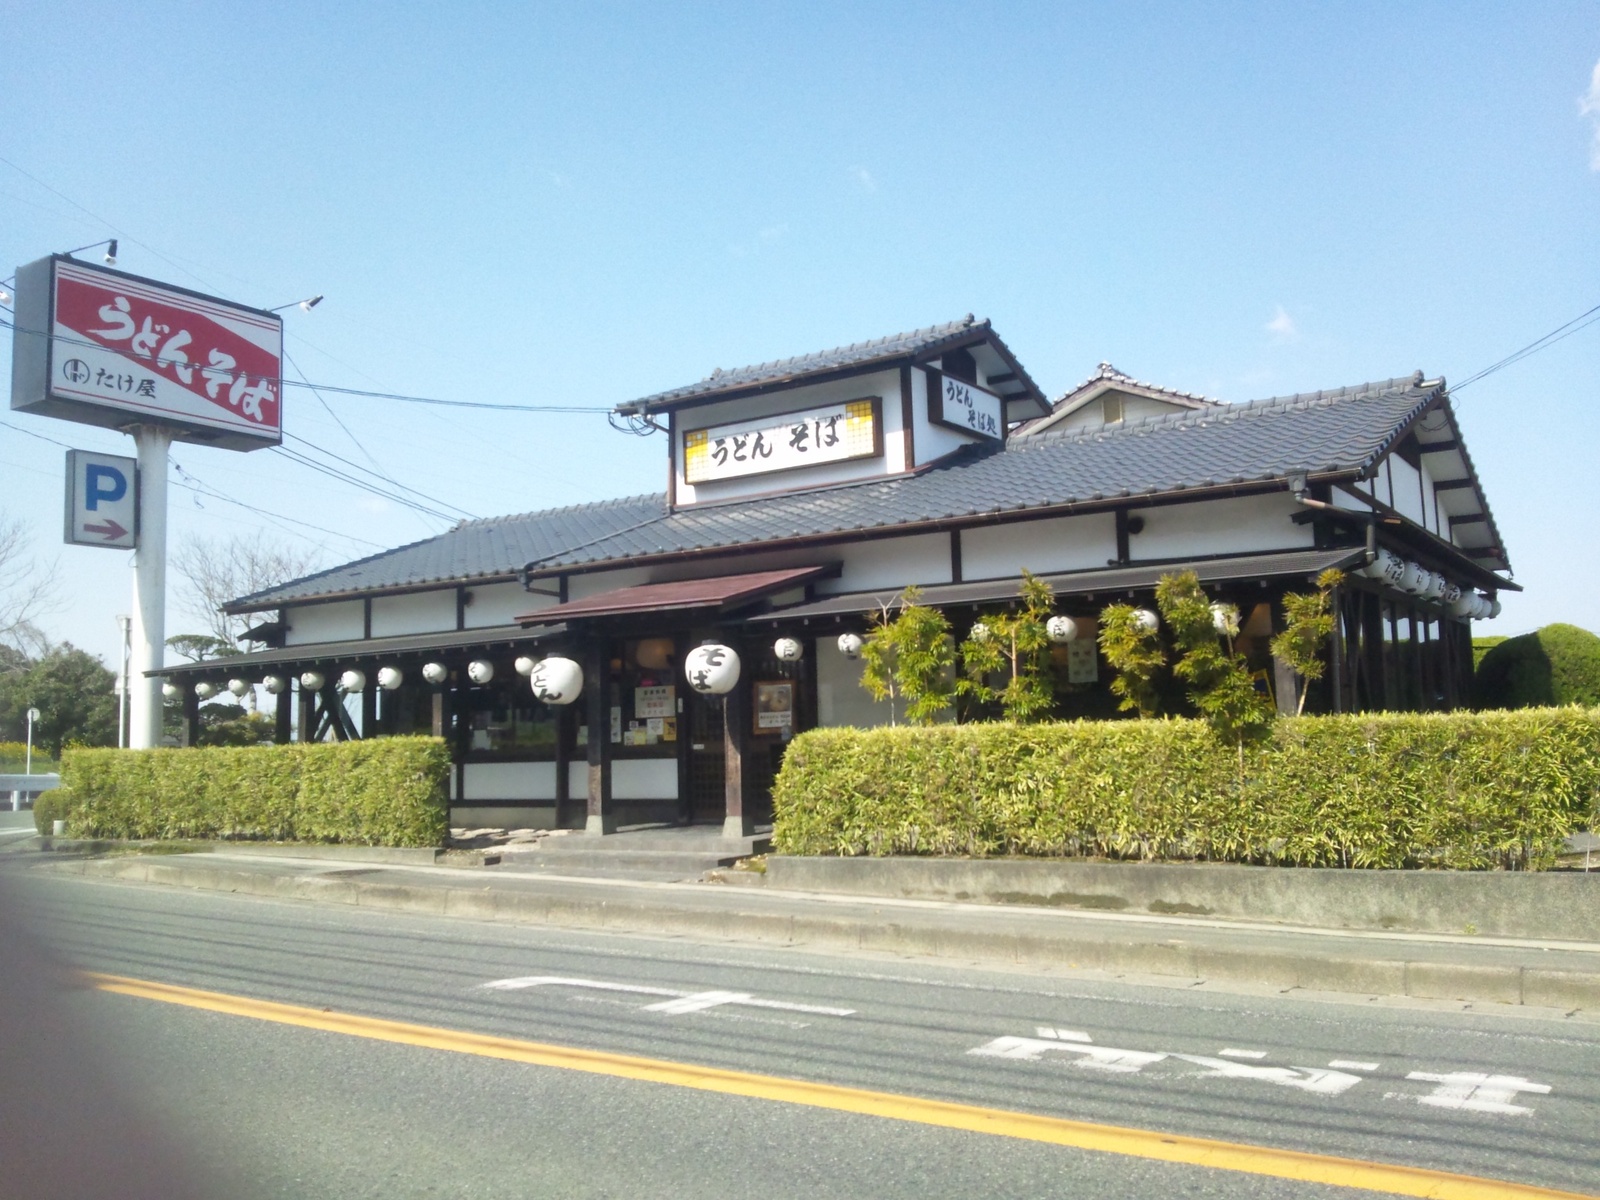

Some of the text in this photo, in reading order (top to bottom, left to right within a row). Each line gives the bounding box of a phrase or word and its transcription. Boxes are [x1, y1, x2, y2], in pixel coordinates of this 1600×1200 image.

[96, 367, 156, 399] たけ屋
[946, 380, 973, 409] うどん
[711, 413, 844, 467] うどん そば
[86, 463, 127, 511] P
[689, 648, 726, 691] そば
